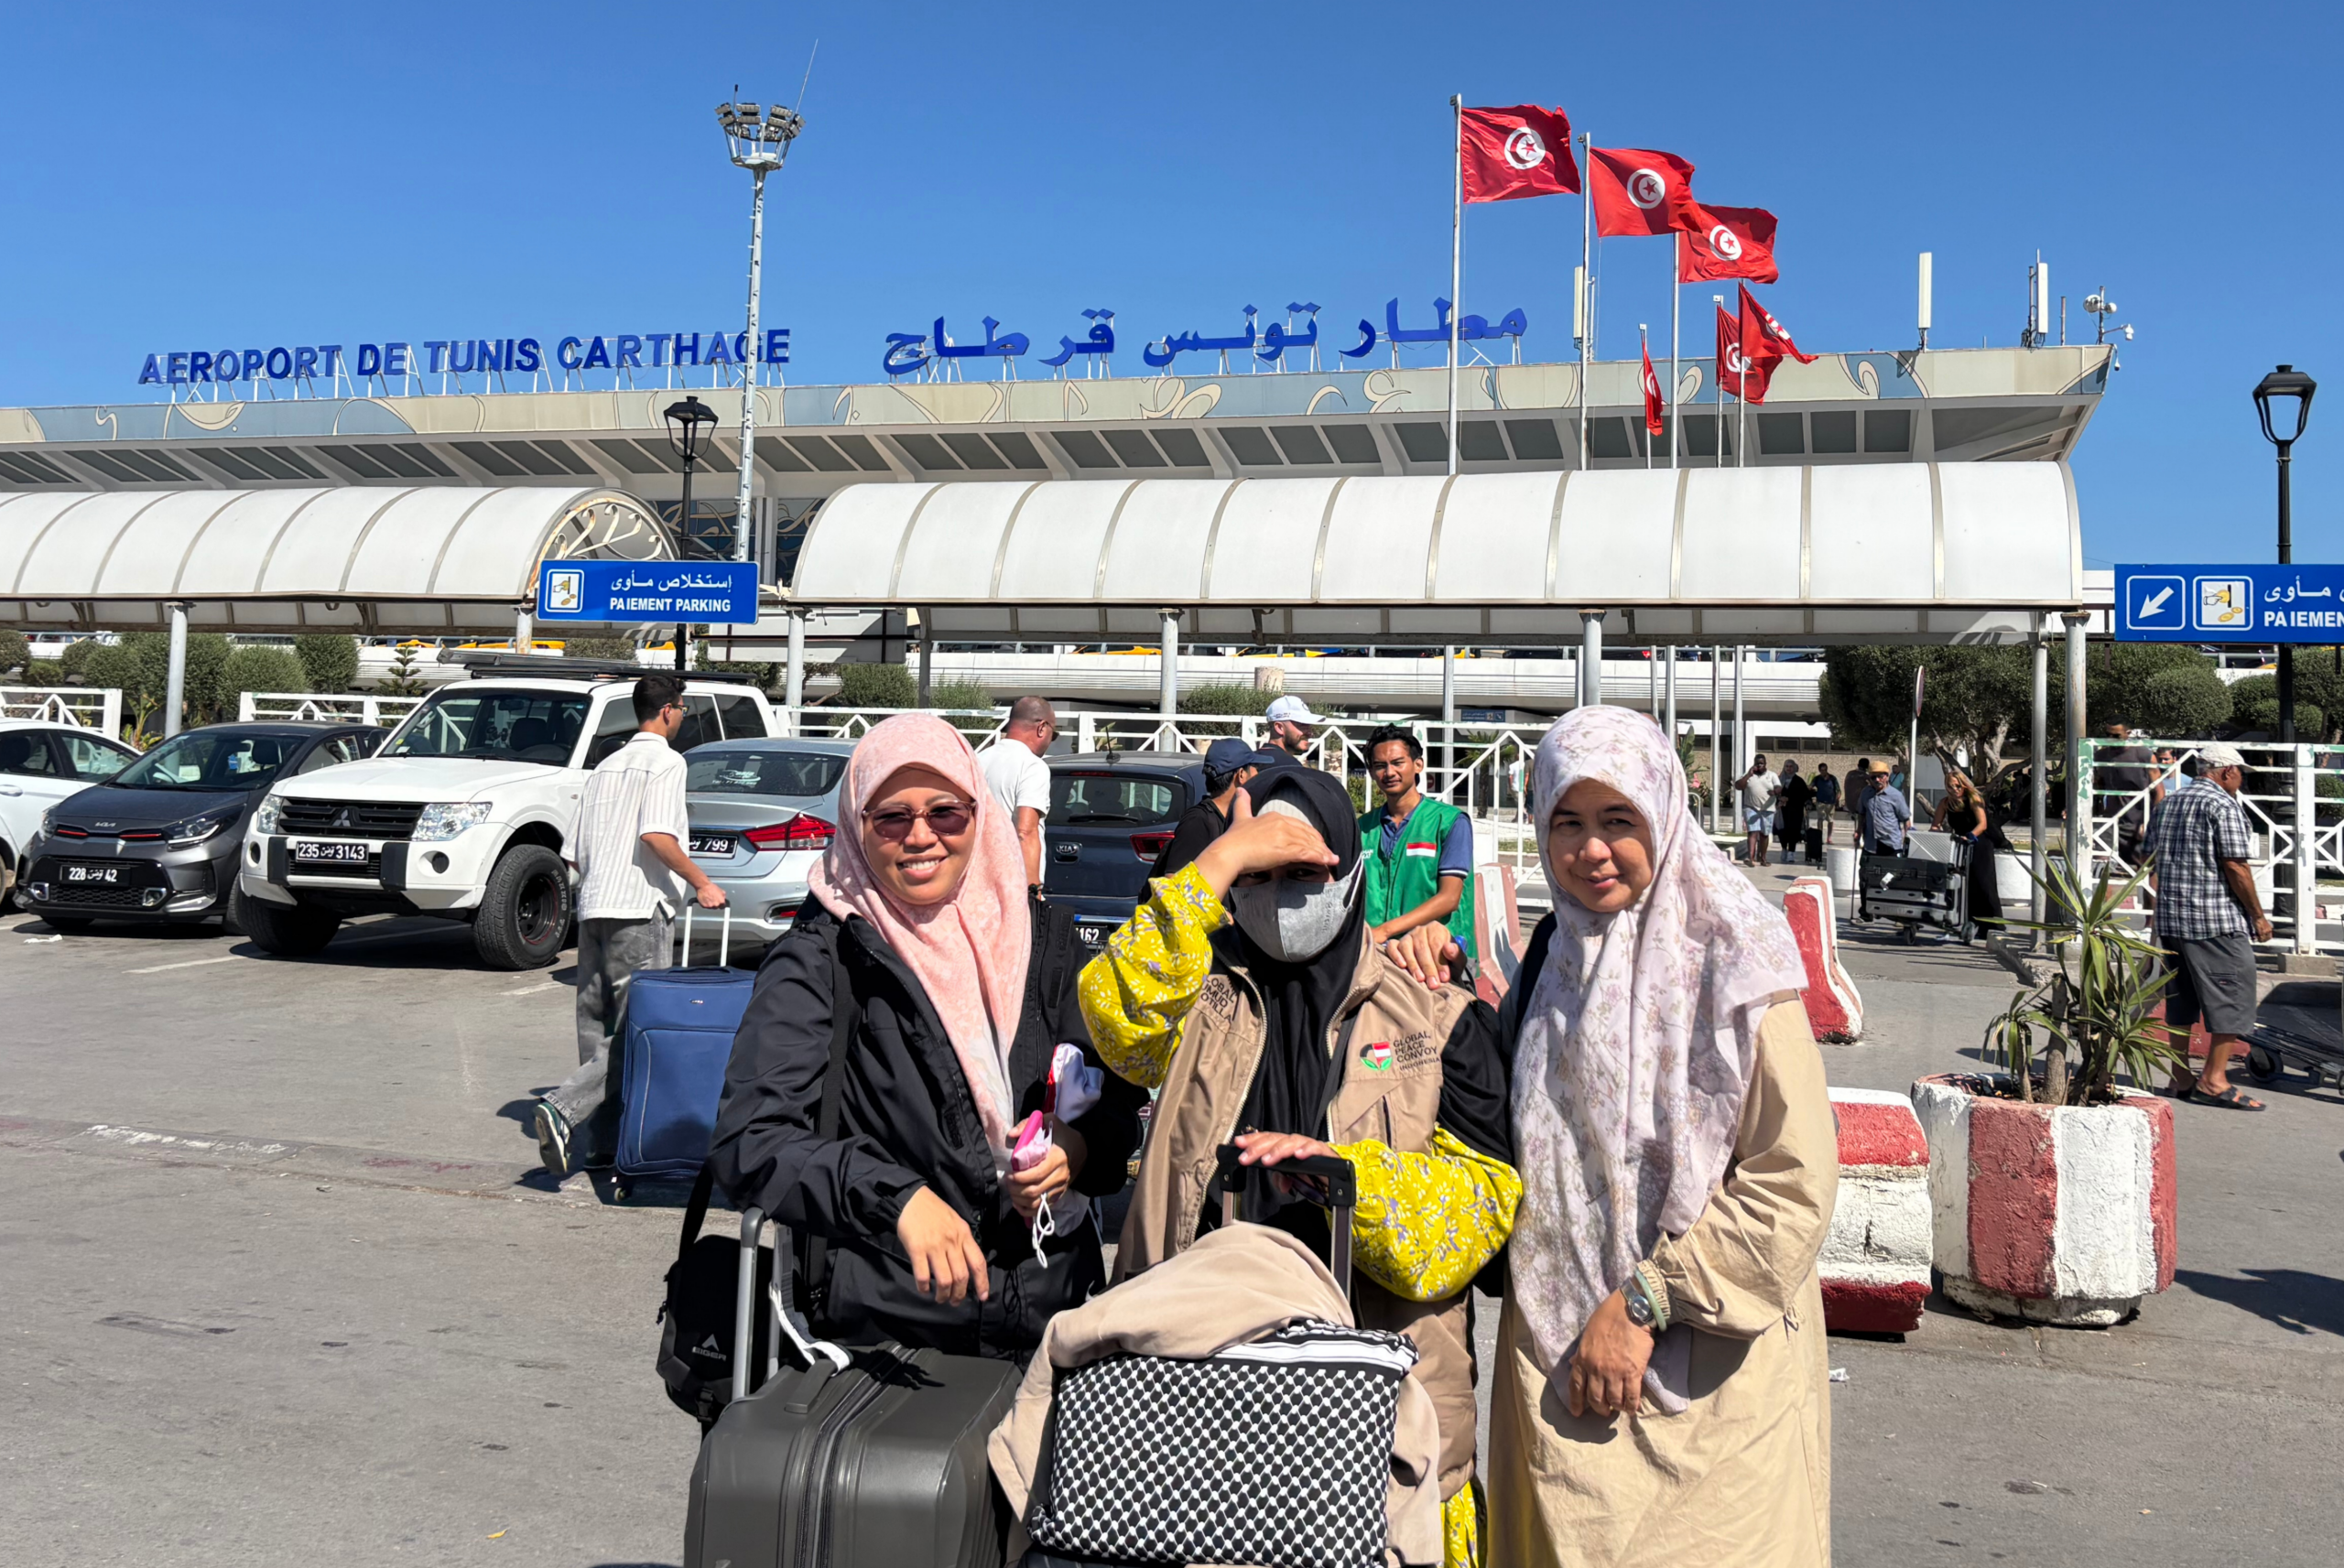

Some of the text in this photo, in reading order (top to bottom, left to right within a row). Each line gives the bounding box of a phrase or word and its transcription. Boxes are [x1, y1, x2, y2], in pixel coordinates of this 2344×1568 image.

[883, 297, 1527, 374] مطار تونس قرطاج
[137, 329, 790, 384] AEROPORT DE TUNIS CARTHAGE
[610, 597, 731, 612] PAIEMENT PARKING
[298, 843, 320, 858] 235
[335, 845, 365, 860] 3143
[704, 838, 729, 851] 799
[69, 867, 87, 881] 228
[104, 869, 117, 882] 42
[1075, 927, 1100, 944] 162
[1206, 978, 1234, 1003] OBAL
[1200, 992, 1232, 1024] OTILLA
[1393, 1030, 1431, 1048] GLOBAL
[1394, 1040, 1426, 1056] PEACE
[1396, 1045, 1438, 1063] CONVOY
[1399, 1057, 1441, 1071] INDONESIA
[691, 1346, 726, 1361] EIGER
